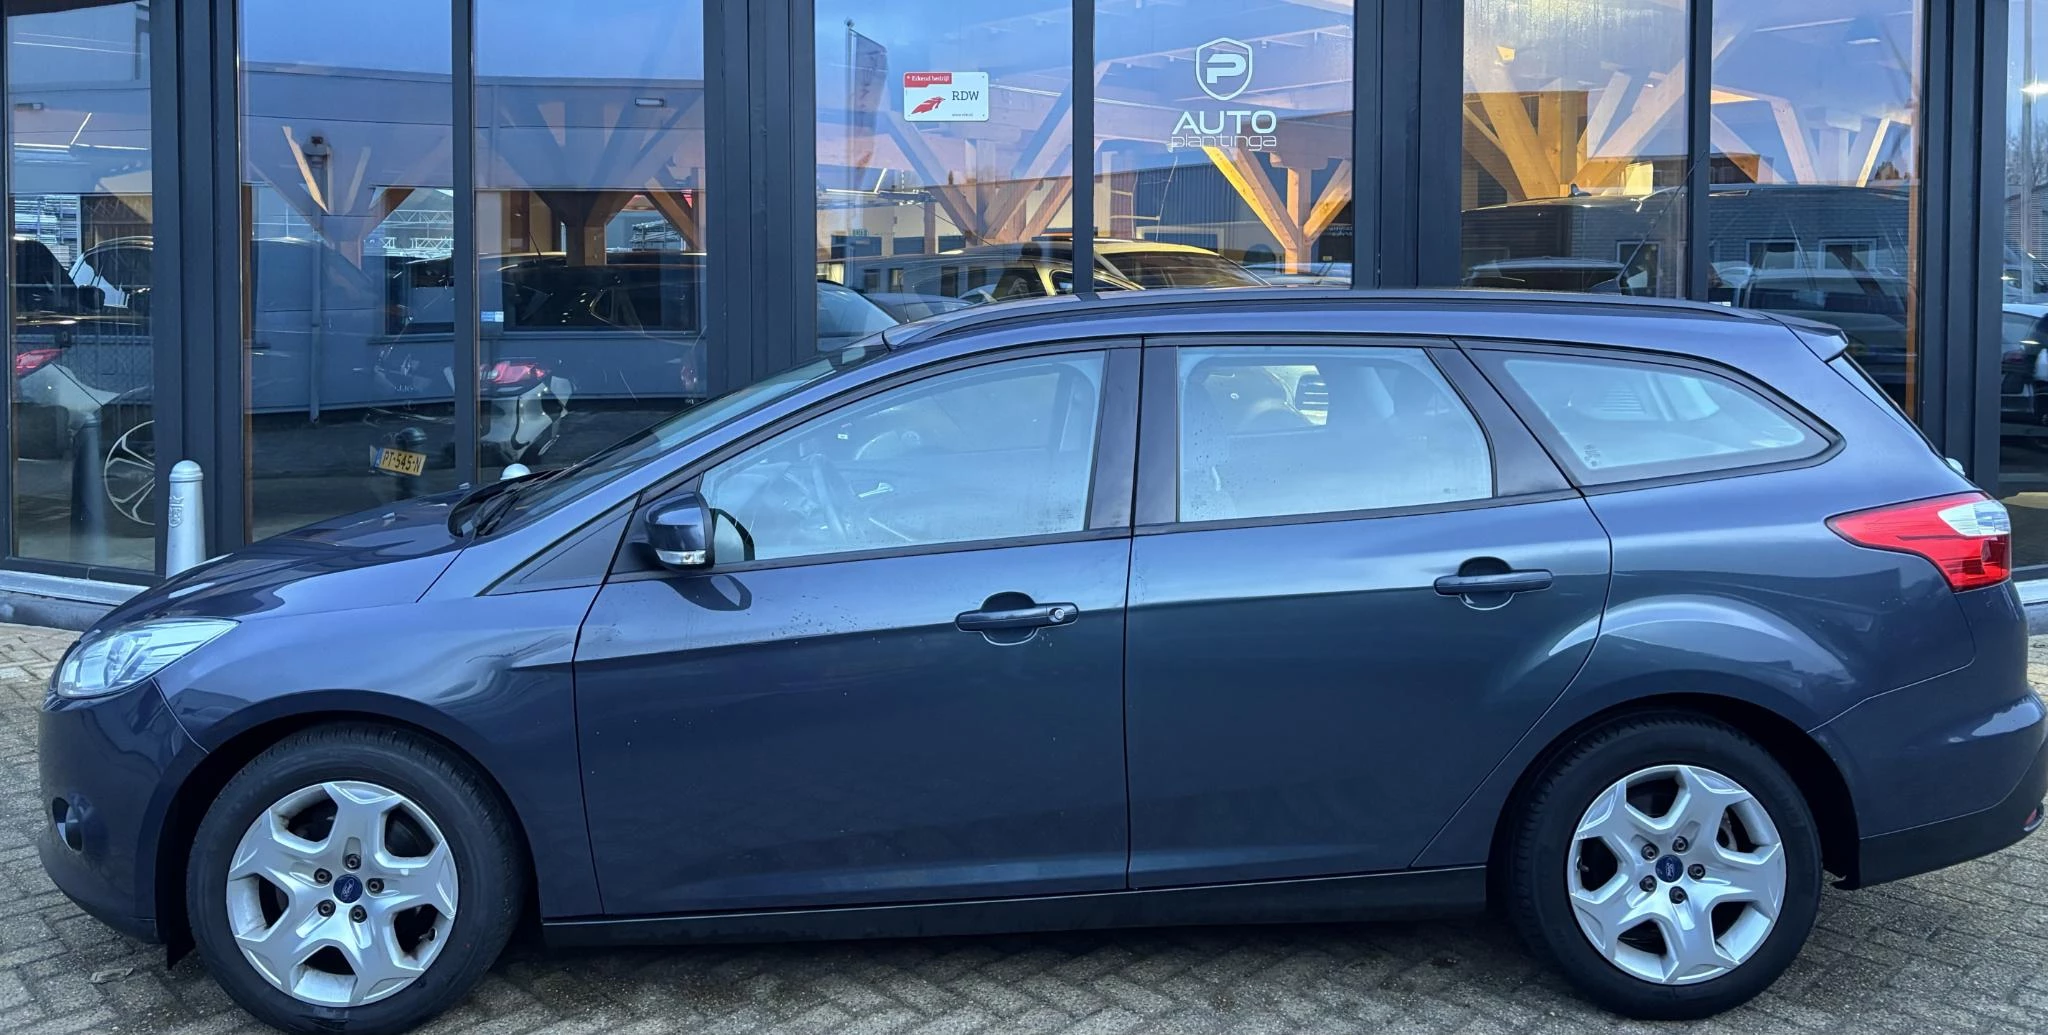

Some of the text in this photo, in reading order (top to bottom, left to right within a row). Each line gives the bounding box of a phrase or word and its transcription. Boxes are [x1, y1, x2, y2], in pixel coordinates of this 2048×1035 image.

[952, 90, 979, 101] RDW
[1172, 110, 1276, 135] AUTO
[1171, 133, 1277, 152] plantinga
[382, 450, 422, 473] PT-545-N
